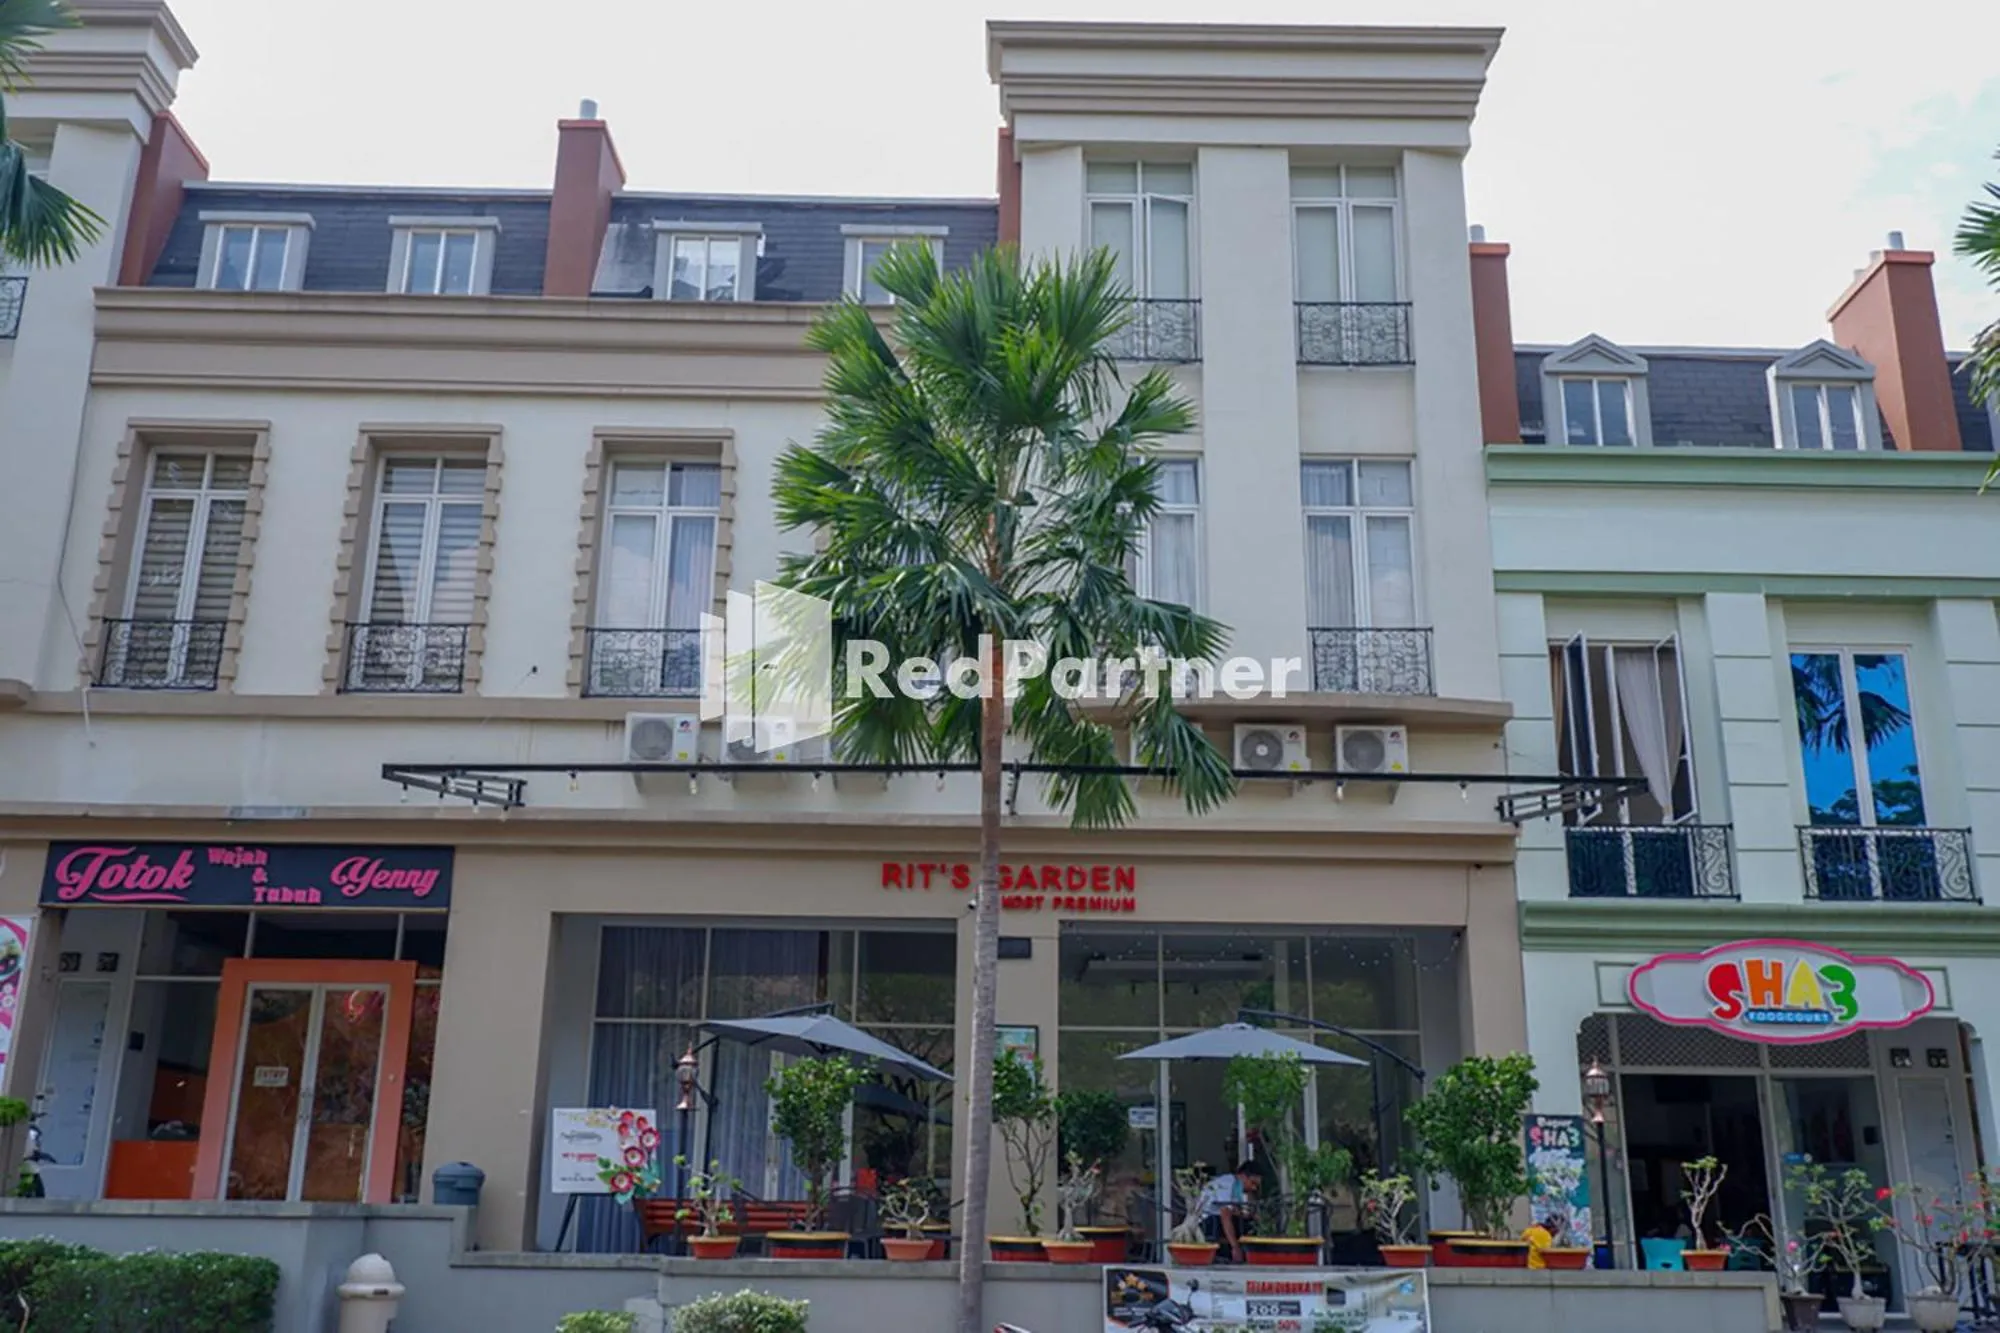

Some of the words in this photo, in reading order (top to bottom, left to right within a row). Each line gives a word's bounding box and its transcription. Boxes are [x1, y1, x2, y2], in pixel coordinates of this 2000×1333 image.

[207, 846, 268, 868] Wajah
[55, 846, 195, 901] Totok
[252, 867, 268, 883] &
[330, 856, 440, 897] Yenny
[881, 863, 971, 889] RIT'S
[997, 864, 1136, 892] GARDEN
[253, 886, 322, 903] Tubuh
[1052, 896, 1136, 912] PREMIUM
[1707, 959, 1859, 1022] SHA3
